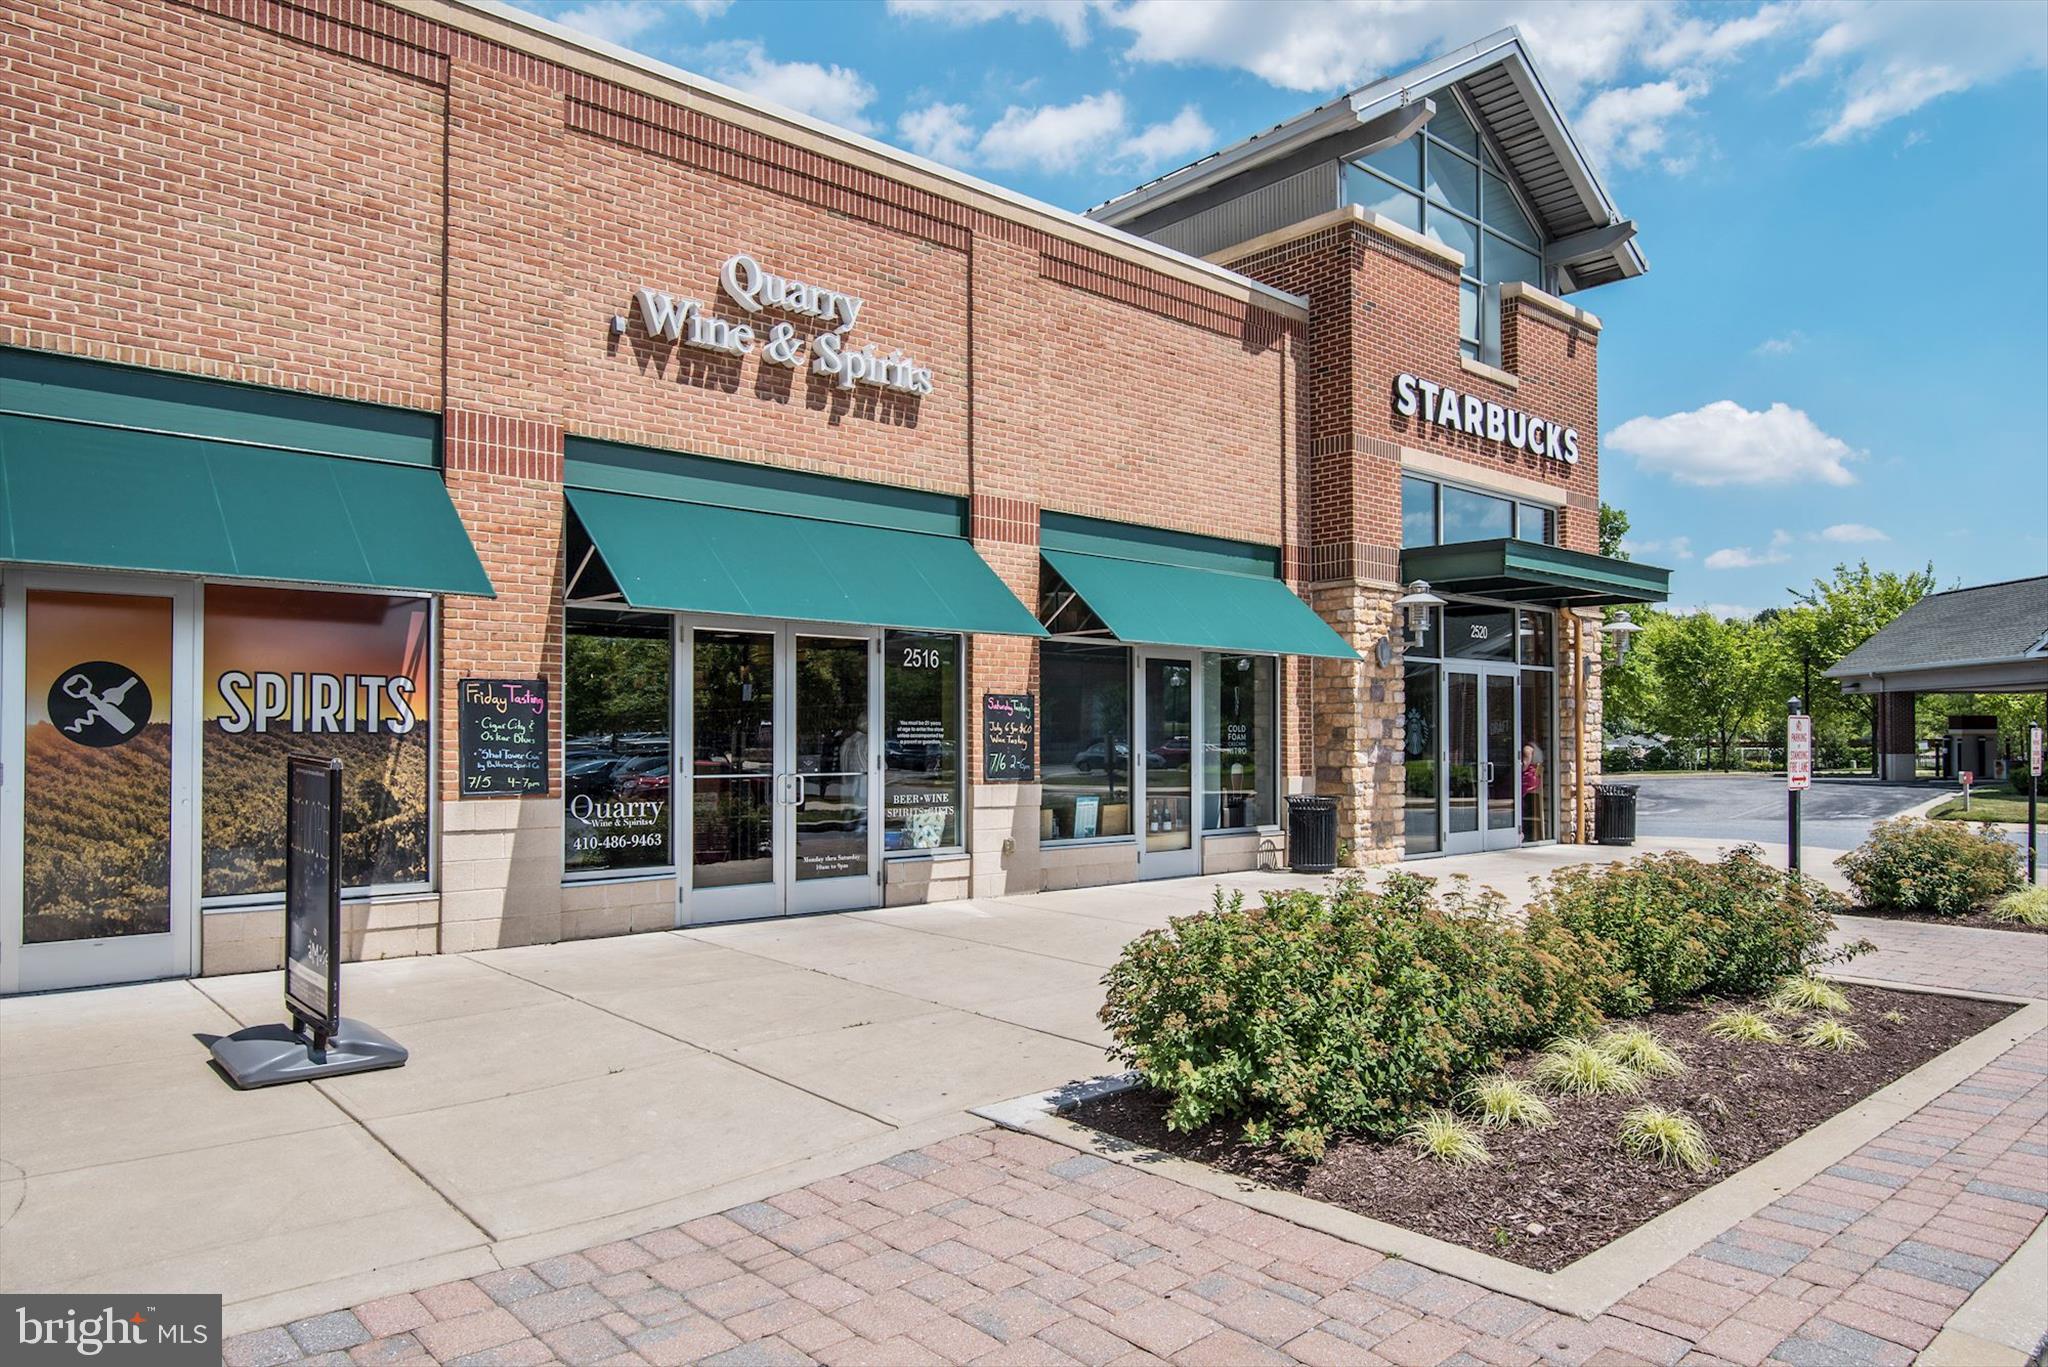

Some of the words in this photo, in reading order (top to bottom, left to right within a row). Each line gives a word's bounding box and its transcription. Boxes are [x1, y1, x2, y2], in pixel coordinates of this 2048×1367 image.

[720, 253, 864, 335] Quarry
[634, 287, 755, 357] Wine
[762, 321, 806, 369] &
[811, 331, 934, 396] Spirits
[1393, 372, 1580, 466] STARBUCKS
[1470, 624, 1488, 639] 2520
[903, 647, 940, 669] 2516
[217, 670, 416, 734] SPIRITS
[466, 683, 508, 713] Friday
[502, 684, 544, 715] Tasting
[481, 716, 506, 733] Cigar
[507, 718, 527, 735] City
[1227, 724, 1247, 733] COLD
[1227, 733, 1247, 741] FOAM
[467, 775, 492, 789] 7/5
[571, 794, 665, 825] Quarry
[591, 819, 613, 828] Wine
[614, 819, 621, 827] &
[623, 818, 649, 828] Spirits
[573, 833, 662, 850] 410-486-9463
